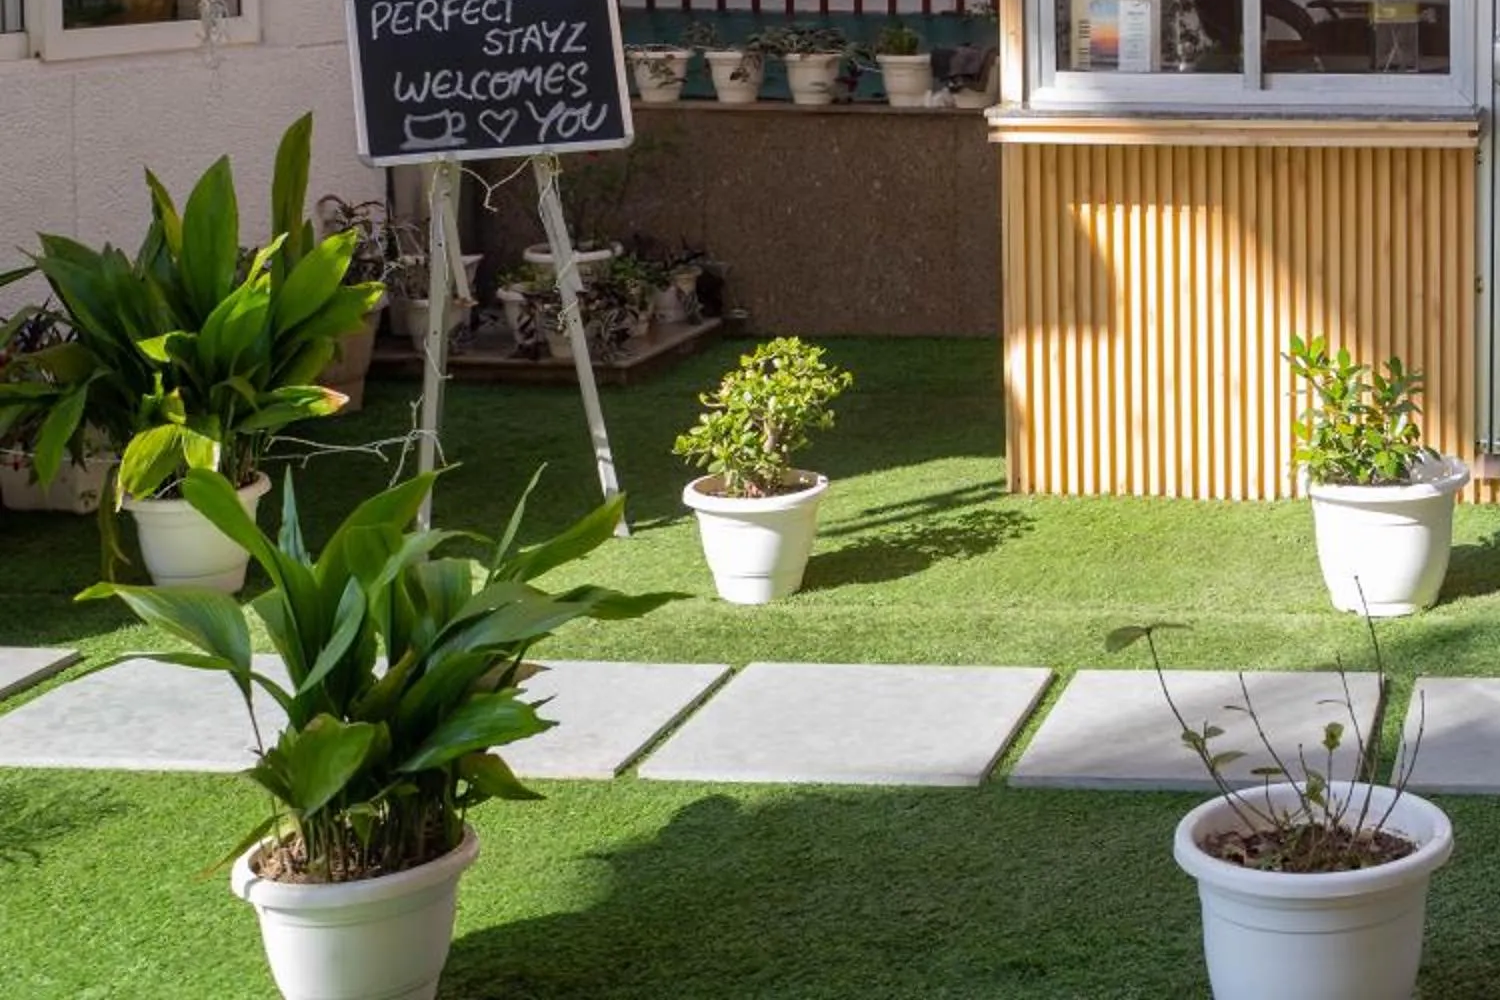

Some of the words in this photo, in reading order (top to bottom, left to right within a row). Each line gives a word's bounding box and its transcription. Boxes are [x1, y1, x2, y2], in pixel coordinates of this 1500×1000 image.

[482, 20, 588, 56] STAYZ
[393, 61, 589, 103] WELCOMES
[525, 100, 608, 143] YOU
